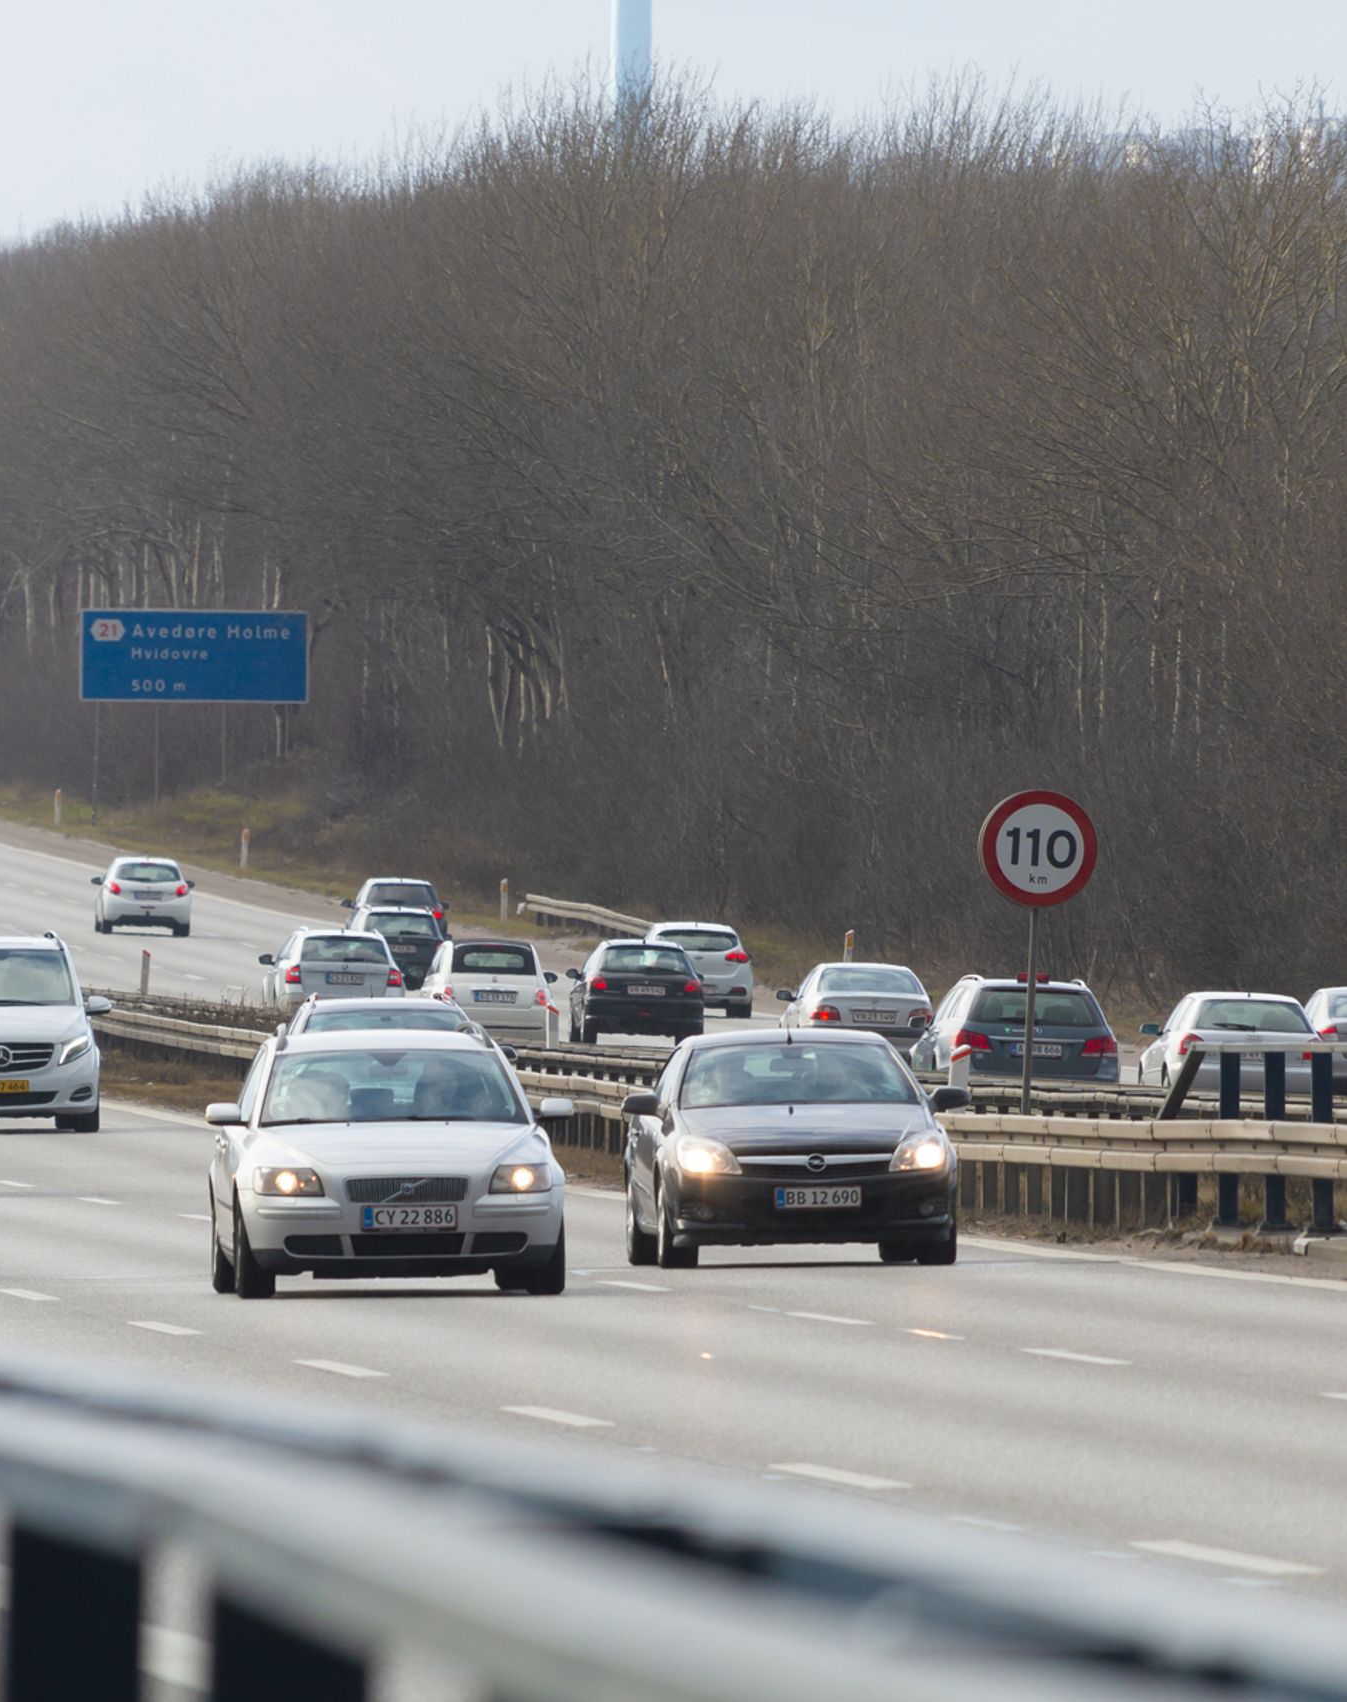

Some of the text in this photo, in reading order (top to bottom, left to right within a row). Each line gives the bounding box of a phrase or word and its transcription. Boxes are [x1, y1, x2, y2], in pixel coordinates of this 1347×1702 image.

[98, 623, 291, 640] 21 Avedøre Holme
[131, 648, 209, 661] Hvidovre
[131, 679, 186, 692] 500 m
[1006, 827, 1077, 869] 110
[1029, 873, 1048, 885] km
[786, 1189, 859, 1205] BB 12 690
[374, 1208, 454, 1225] CY 22 886
